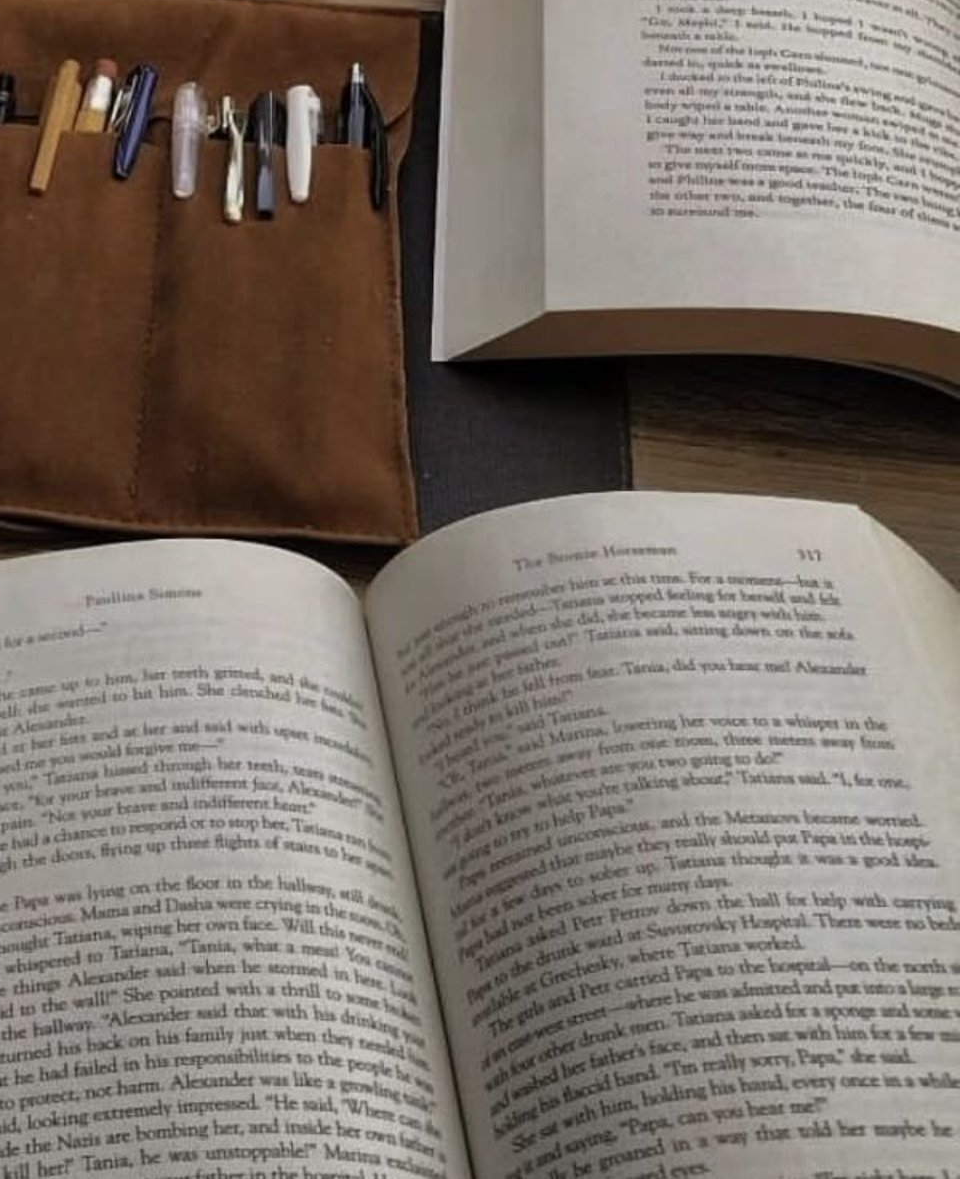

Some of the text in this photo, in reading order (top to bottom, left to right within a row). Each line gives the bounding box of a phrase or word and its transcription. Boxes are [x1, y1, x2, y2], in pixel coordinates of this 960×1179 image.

[13, 895, 49, 910] Papa
[54, 892, 82, 903] was
[86, 885, 125, 901] lying
[128, 884, 151, 894] on
[154, 877, 181, 892] the
[185, 875, 220, 890] floor
[226, 876, 243, 889] in
[246, 874, 273, 889] the
[12, 979, 61, 994] things
[67, 966, 150, 986] Alexander
[154, 961, 186, 977] said
[190, 959, 236, 974] when
[240, 958, 261, 973] he
[267, 963, 328, 977] stormed
[333, 967, 350, 981] in
[13, 1070, 34, 1085] he
[38, 1065, 69, 1081] had
[73, 1058, 118, 1077] failed
[122, 1057, 141, 1071] in
[144, 1054, 170, 1069] his
[173, 1049, 292, 1067] responsibilities
[295, 1053, 314, 1064] to
[316, 1050, 343, 1066] the
[346, 1059, 392, 1077] people
[24, 1138, 52, 1154] the
[56, 1133, 101, 1149] Nazis
[105, 1133, 130, 1144] are
[134, 1123, 209, 1140] bombing
[248, 1117, 280, 1133] and
[284, 1119, 332, 1134] inside
[334, 1120, 362, 1138] her
